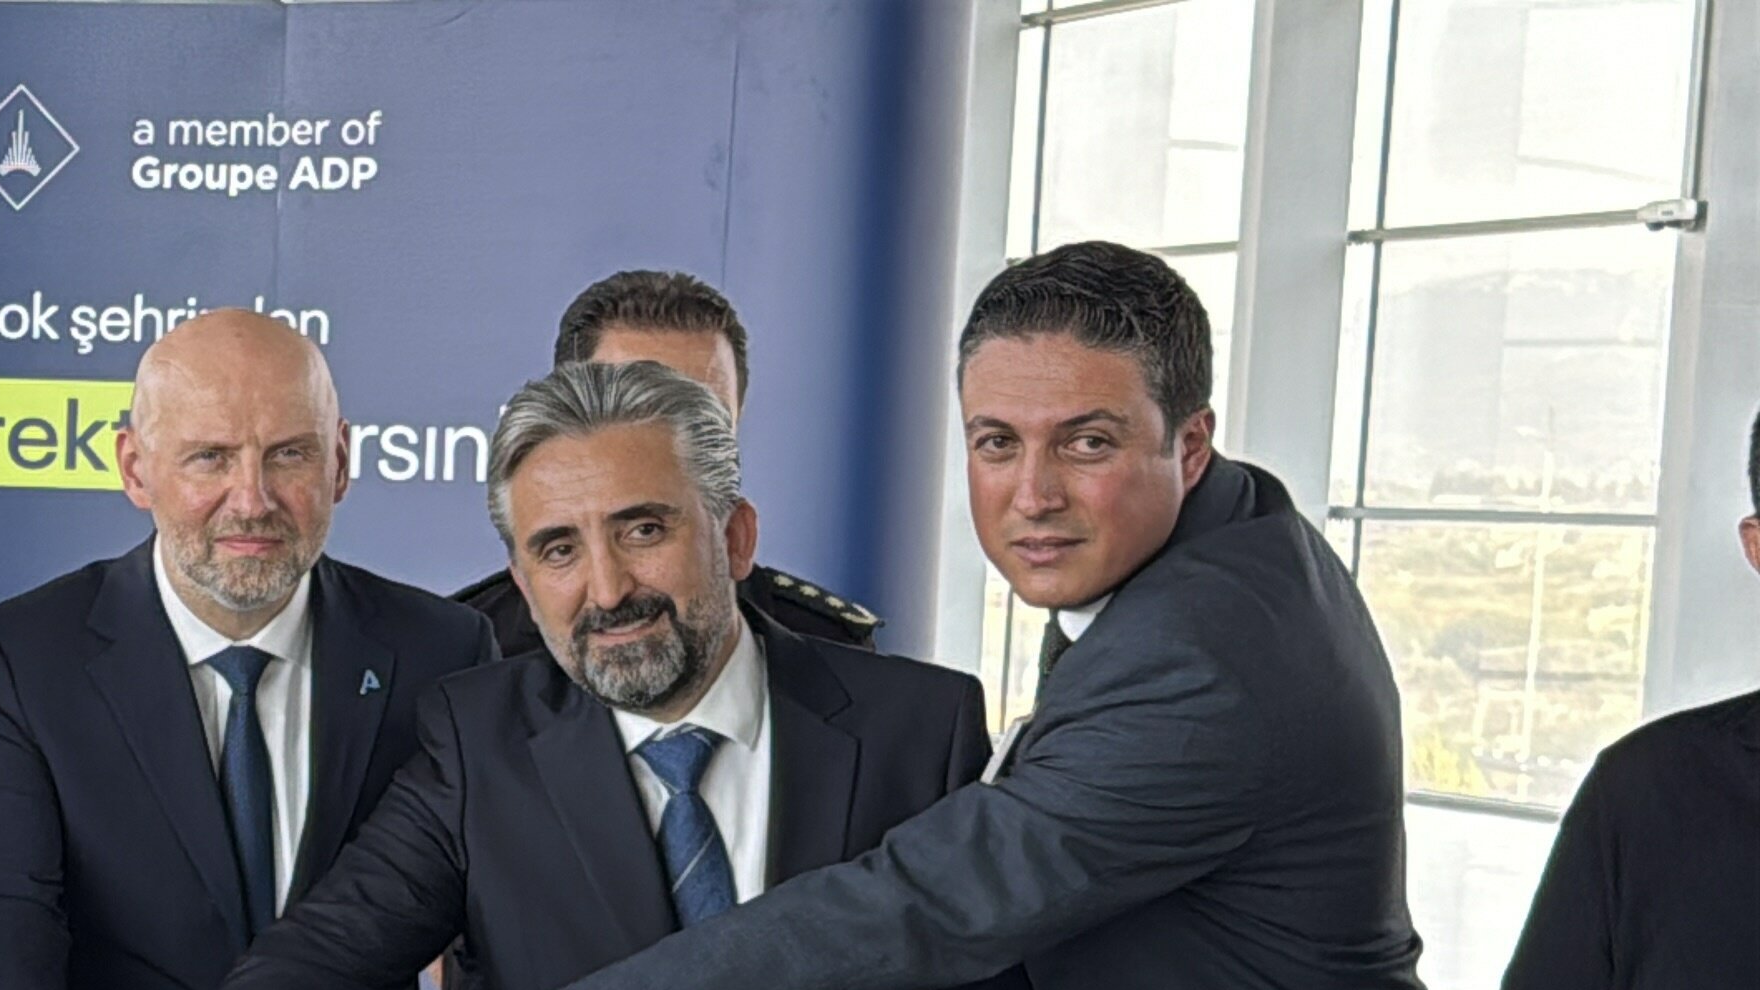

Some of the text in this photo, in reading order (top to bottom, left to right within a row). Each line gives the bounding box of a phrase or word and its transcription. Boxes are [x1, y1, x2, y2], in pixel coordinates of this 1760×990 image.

[132, 110, 382, 147] a member of
[131, 155, 377, 197] Groupe ADP
[350, 404, 507, 482] rsın
